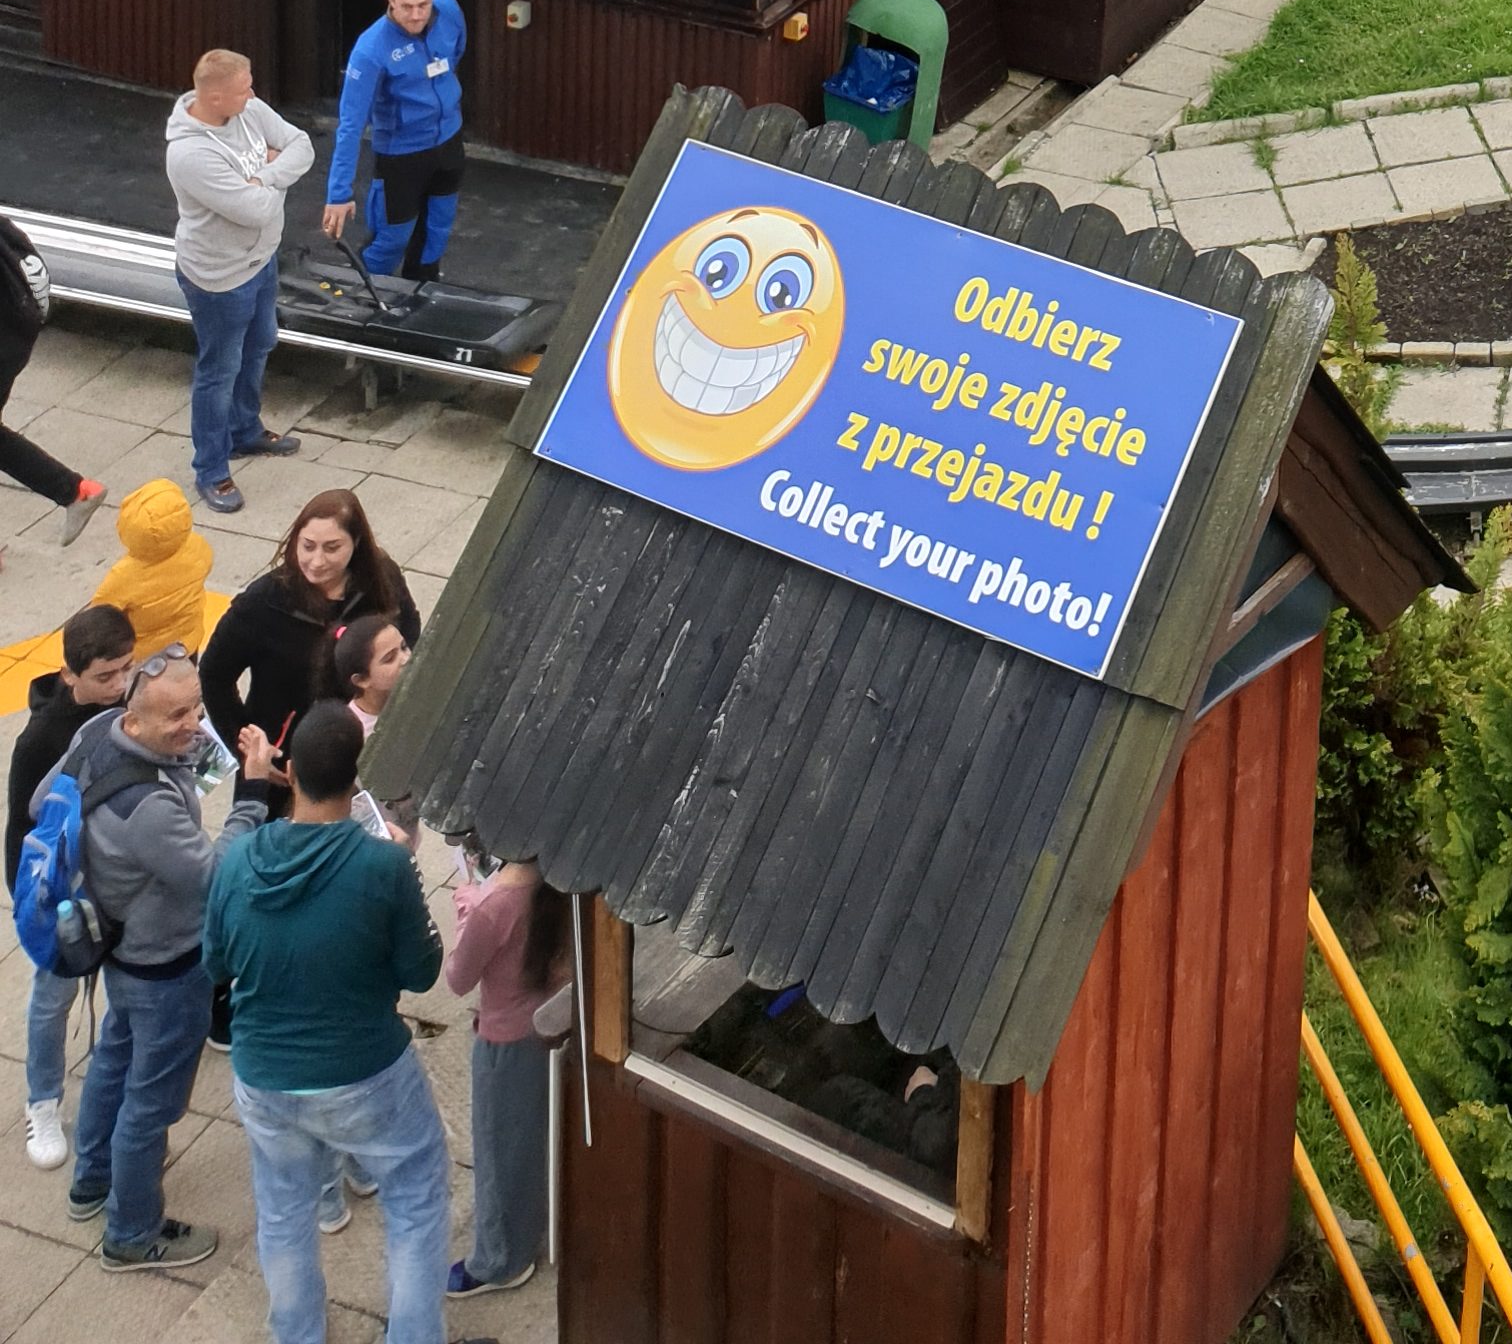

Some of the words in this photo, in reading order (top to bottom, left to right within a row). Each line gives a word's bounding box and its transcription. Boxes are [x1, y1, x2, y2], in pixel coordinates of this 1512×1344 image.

[954, 277, 1122, 372] Odbierz
[862, 338, 989, 411] swoje
[989, 382, 1147, 466] zdjęcie
[837, 412, 870, 452] z
[862, 424, 1085, 532] przejazdu
[1086, 491, 1113, 540] !
[760, 469, 885, 550] Collect
[880, 524, 976, 584] your
[967, 558, 1113, 638] photo!
